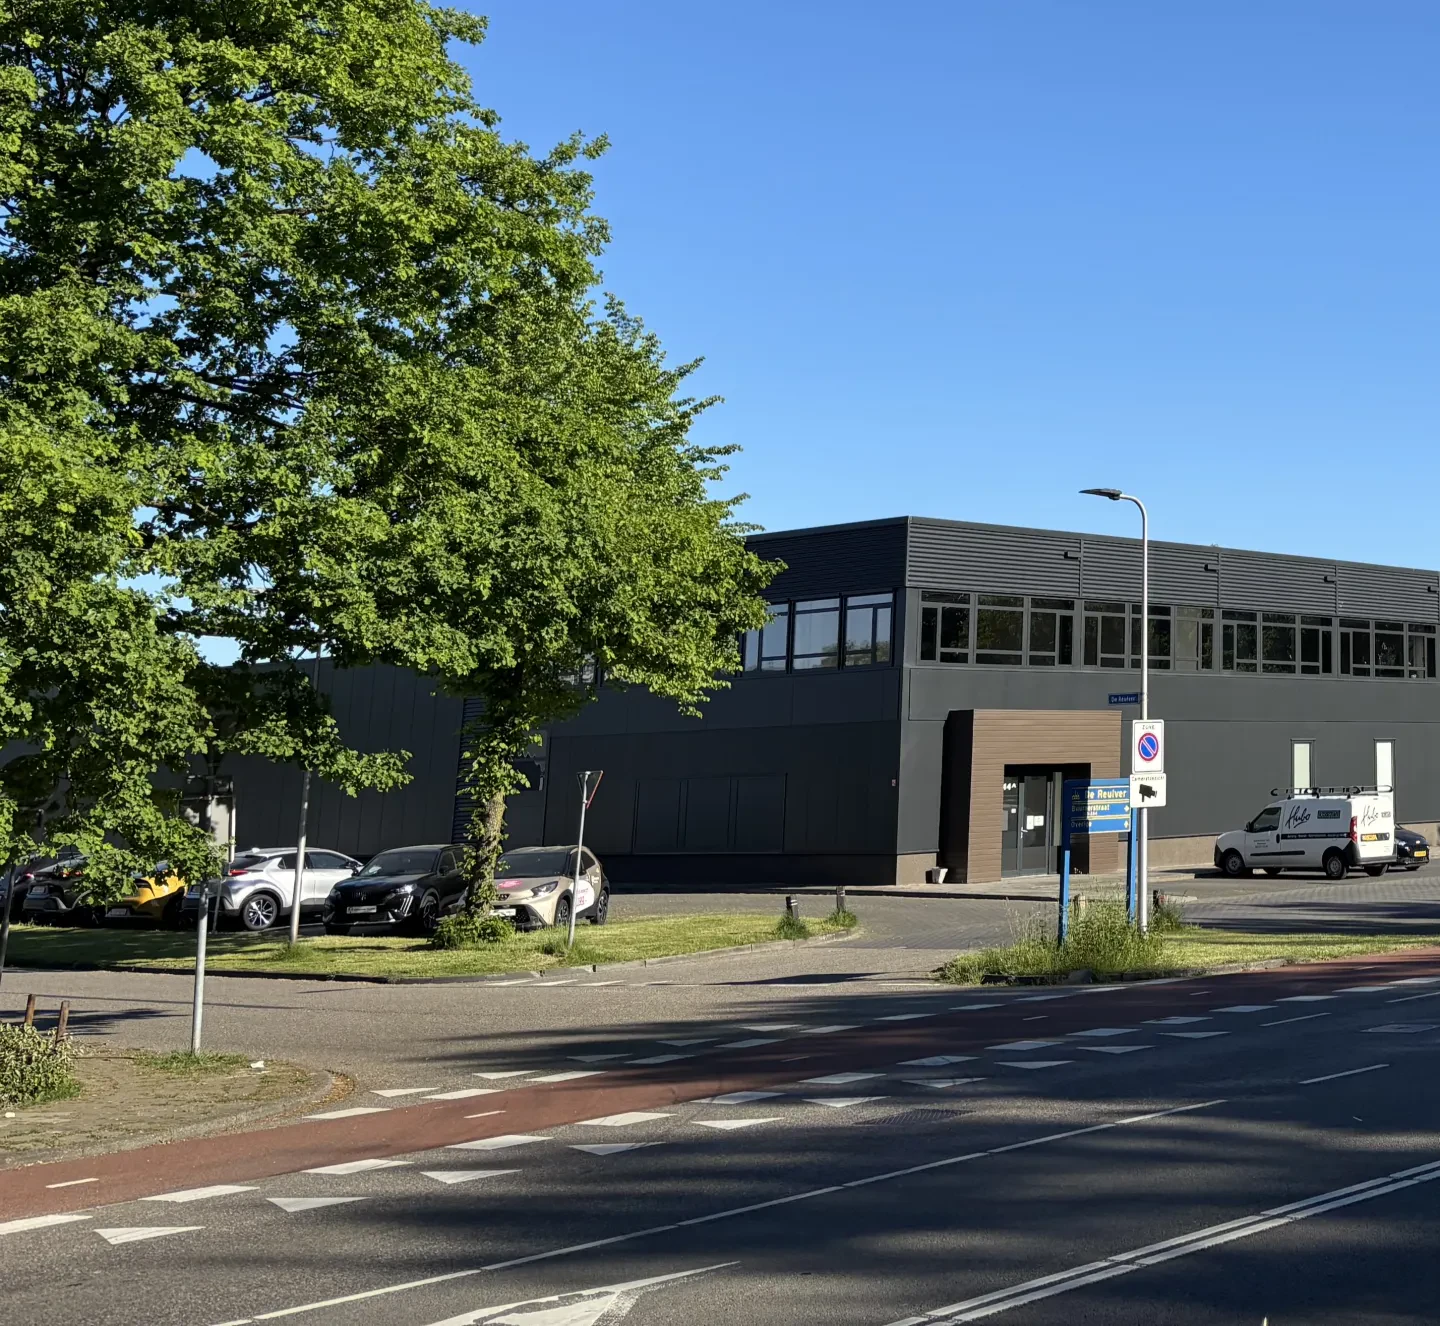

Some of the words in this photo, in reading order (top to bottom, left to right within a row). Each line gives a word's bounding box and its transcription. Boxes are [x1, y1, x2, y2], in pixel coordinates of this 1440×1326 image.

[1084, 790, 1095, 799] De
[1097, 788, 1127, 799] Reulver
[1285, 805, 1311, 829] Hubo
